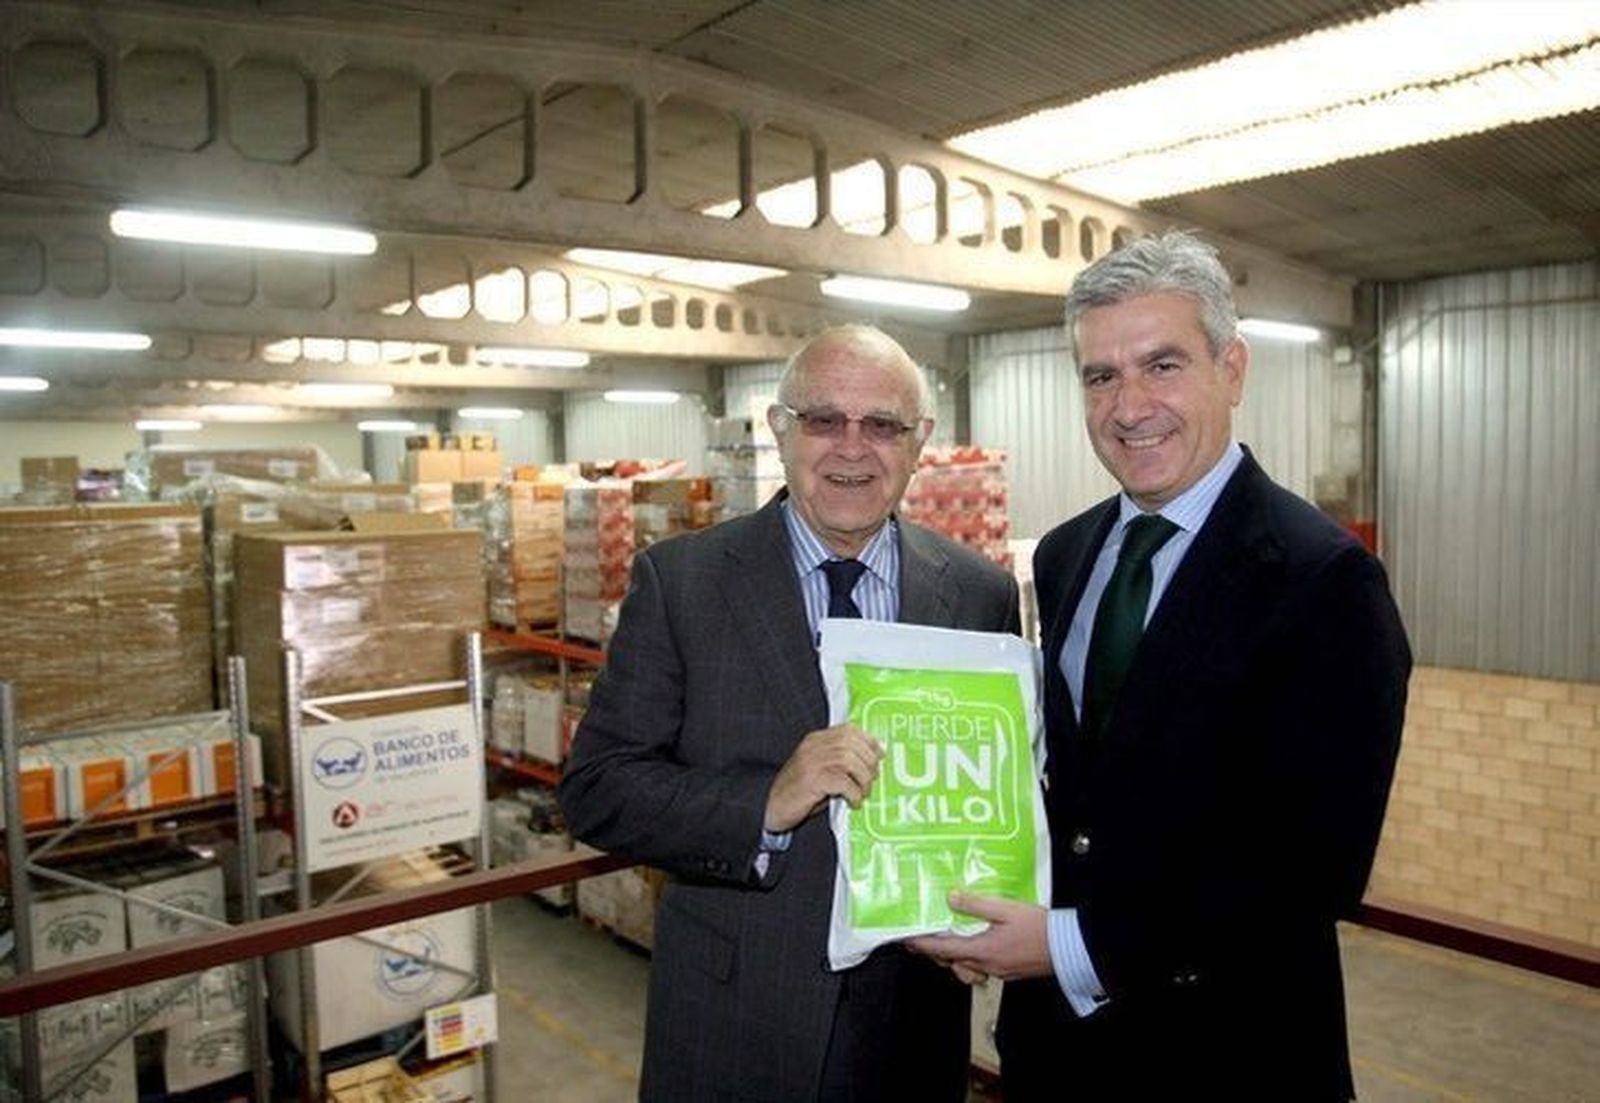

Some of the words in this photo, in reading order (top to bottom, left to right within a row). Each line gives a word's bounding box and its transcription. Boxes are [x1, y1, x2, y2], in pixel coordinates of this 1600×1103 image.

[891, 713, 990, 740] PIERDE
[373, 734, 434, 757] BANCO
[438, 728, 459, 745] DE
[374, 743, 471, 772] ALIMENTOS
[893, 743, 992, 790] UN
[901, 794, 992, 824] KILO
